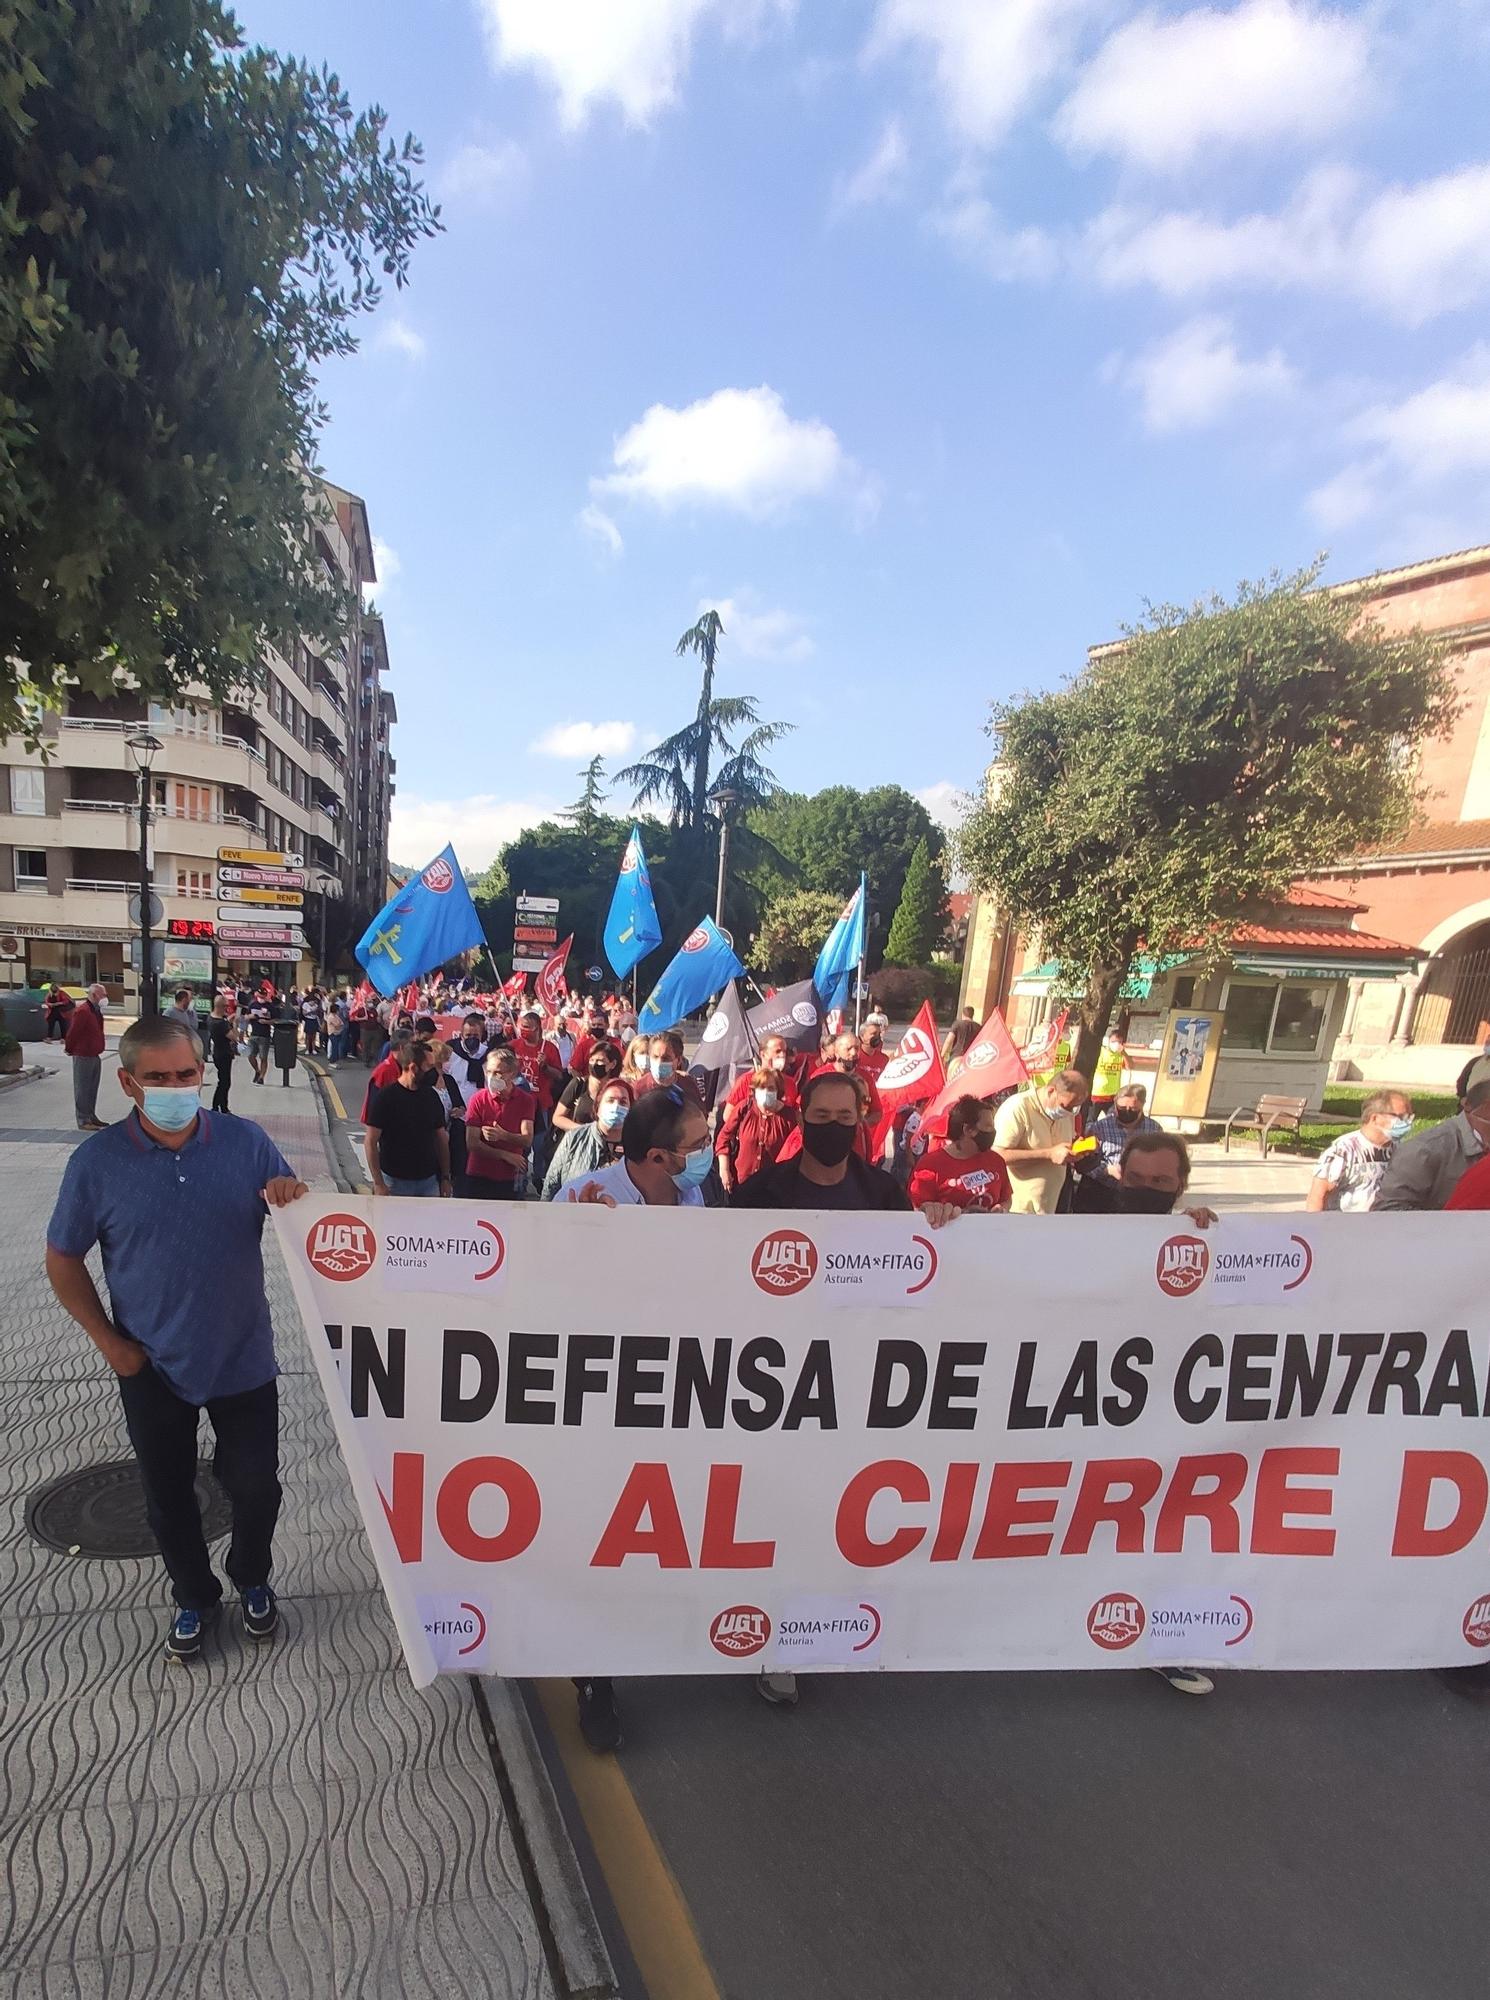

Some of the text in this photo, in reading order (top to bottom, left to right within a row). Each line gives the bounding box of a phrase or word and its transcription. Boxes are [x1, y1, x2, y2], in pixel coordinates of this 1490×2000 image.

[222, 850, 242, 859] FEVE
[276, 893, 300, 903] RENFE
[251, 949, 262, 957] San
[263, 950, 281, 958] Pedro
[313, 1224, 369, 1252] UGT
[759, 1240, 811, 1267] UGT
[1163, 1244, 1205, 1271] UGT
[386, 1255, 428, 1268] Asturias
[824, 1273, 863, 1284] Asturias
[1213, 1273, 1246, 1283] Asturias
[440, 1329, 838, 1432] DEFENSA
[865, 1338, 988, 1431] DE
[1006, 1336, 1154, 1431] LAS
[1173, 1329, 1490, 1425] CENTRA
[589, 1461, 776, 1569] AL
[835, 1446, 1341, 1568] CIERRE
[1391, 1449, 1489, 1558] D
[1093, 1602, 1139, 1627] UGT
[434, 1620, 473, 1635] FITAG
[717, 1613, 765, 1635] UGT
[1150, 1627, 1186, 1638] Asturias
[778, 1637, 814, 1646] Asturias
